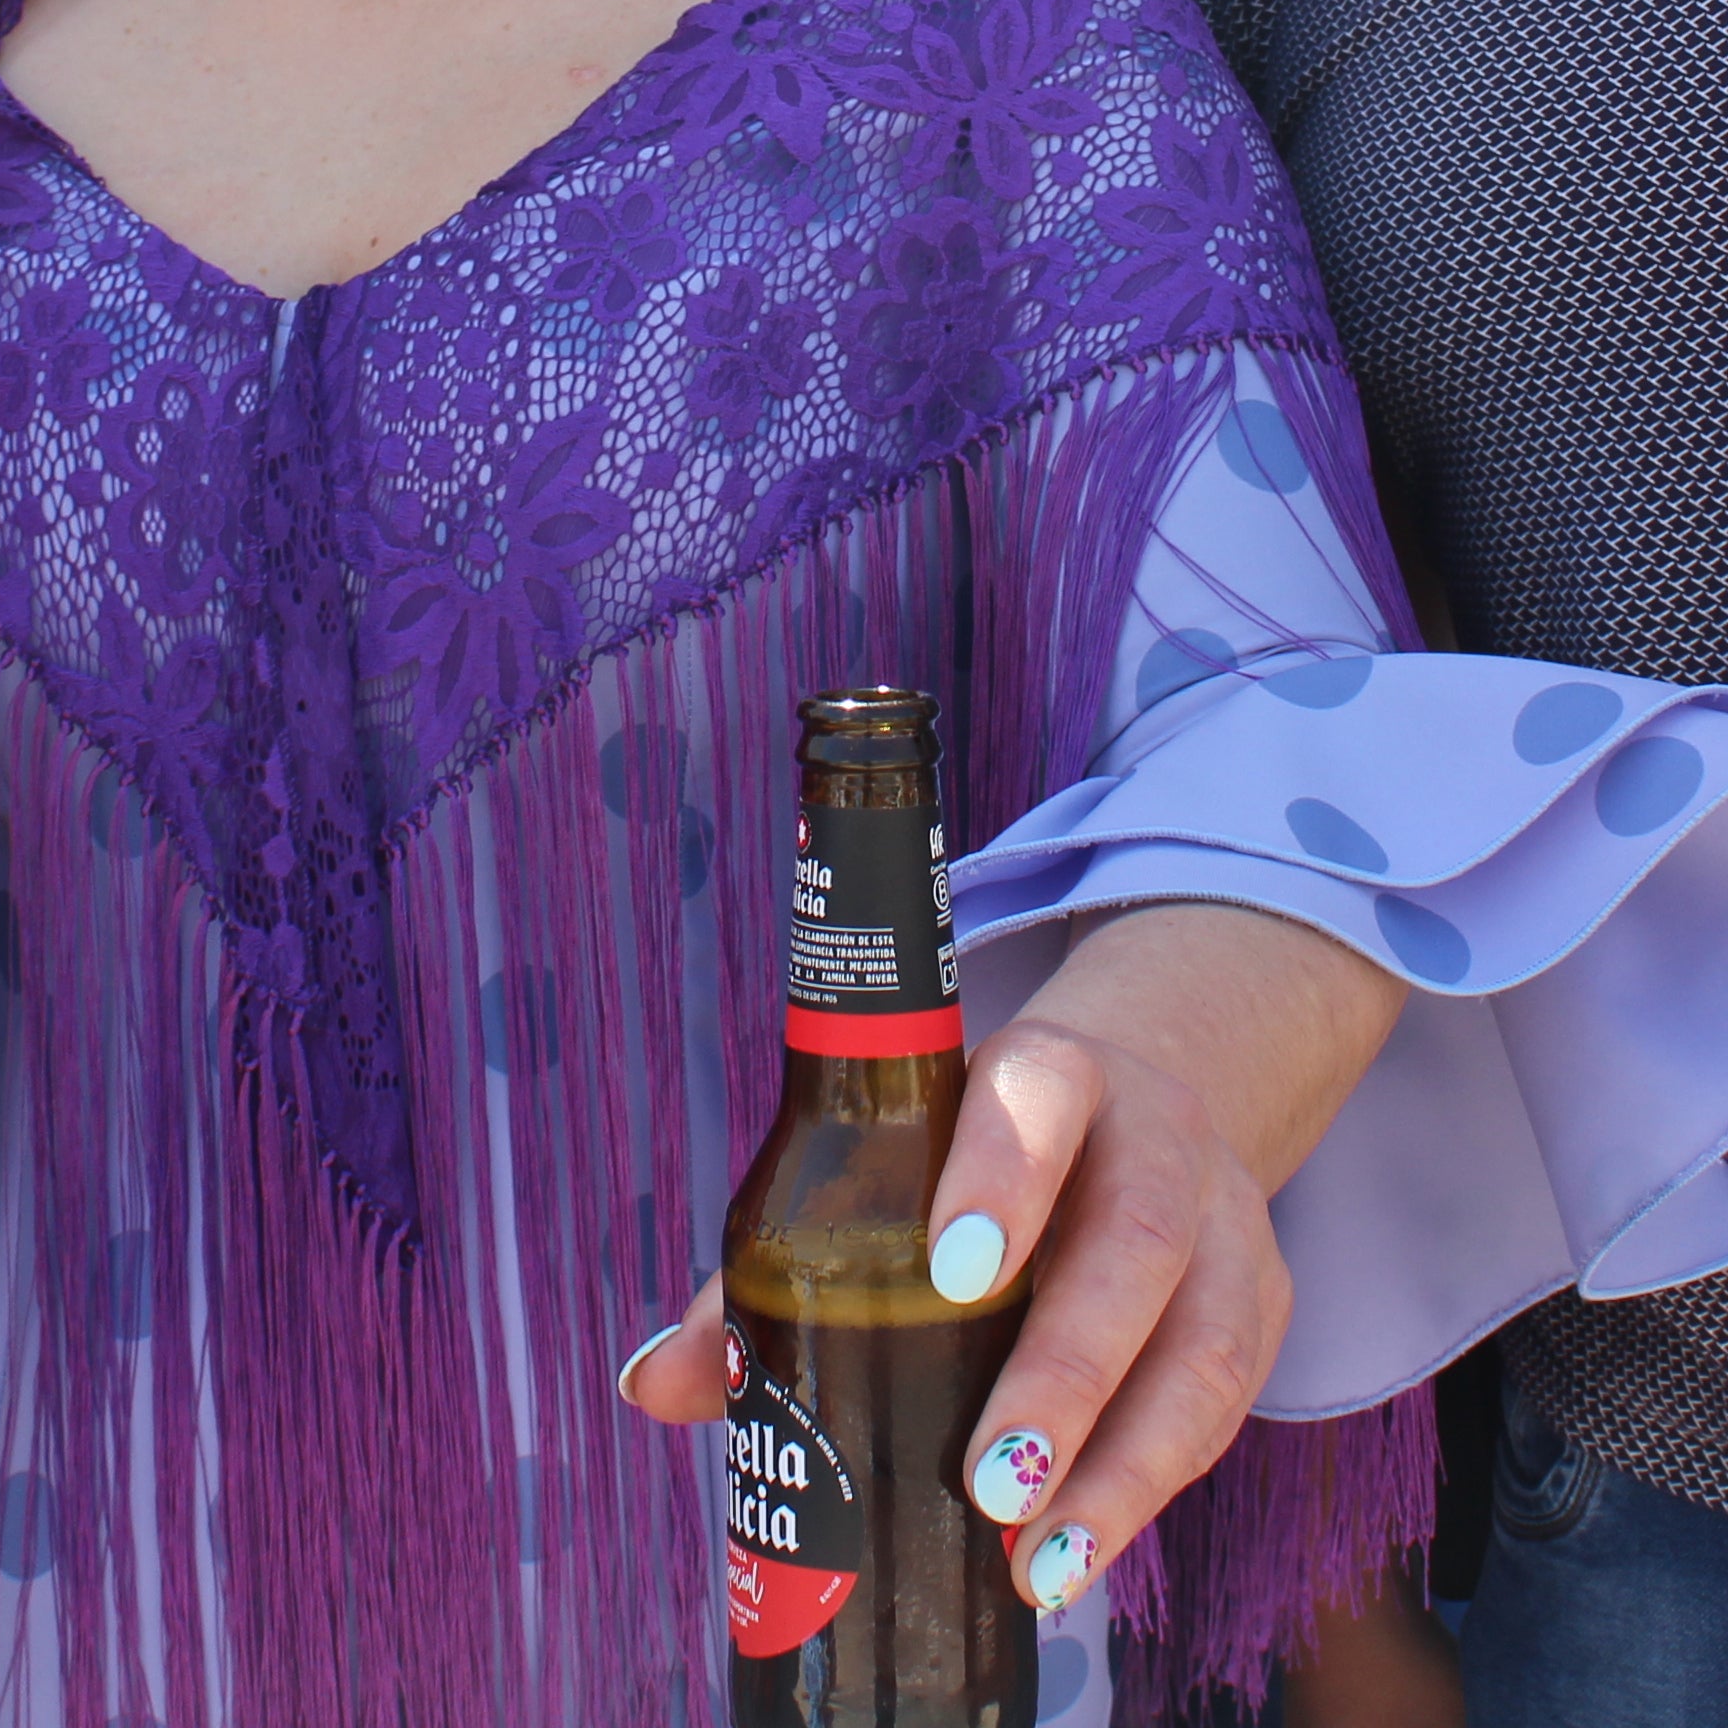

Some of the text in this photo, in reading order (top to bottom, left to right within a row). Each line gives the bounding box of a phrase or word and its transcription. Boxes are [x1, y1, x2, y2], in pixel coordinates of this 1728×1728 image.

[858, 935, 870, 946] DE
[872, 935, 894, 946] ESTA
[836, 947, 896, 959] TRANSMITIDA
[849, 960, 898, 972] MEJORADA
[821, 971, 856, 984] FAMILIA
[865, 973, 899, 985] RIVERA
[764, 1379, 782, 1401] BIER
[815, 1433, 839, 1467] BIRRA
[837, 1473, 854, 1503] BEER
